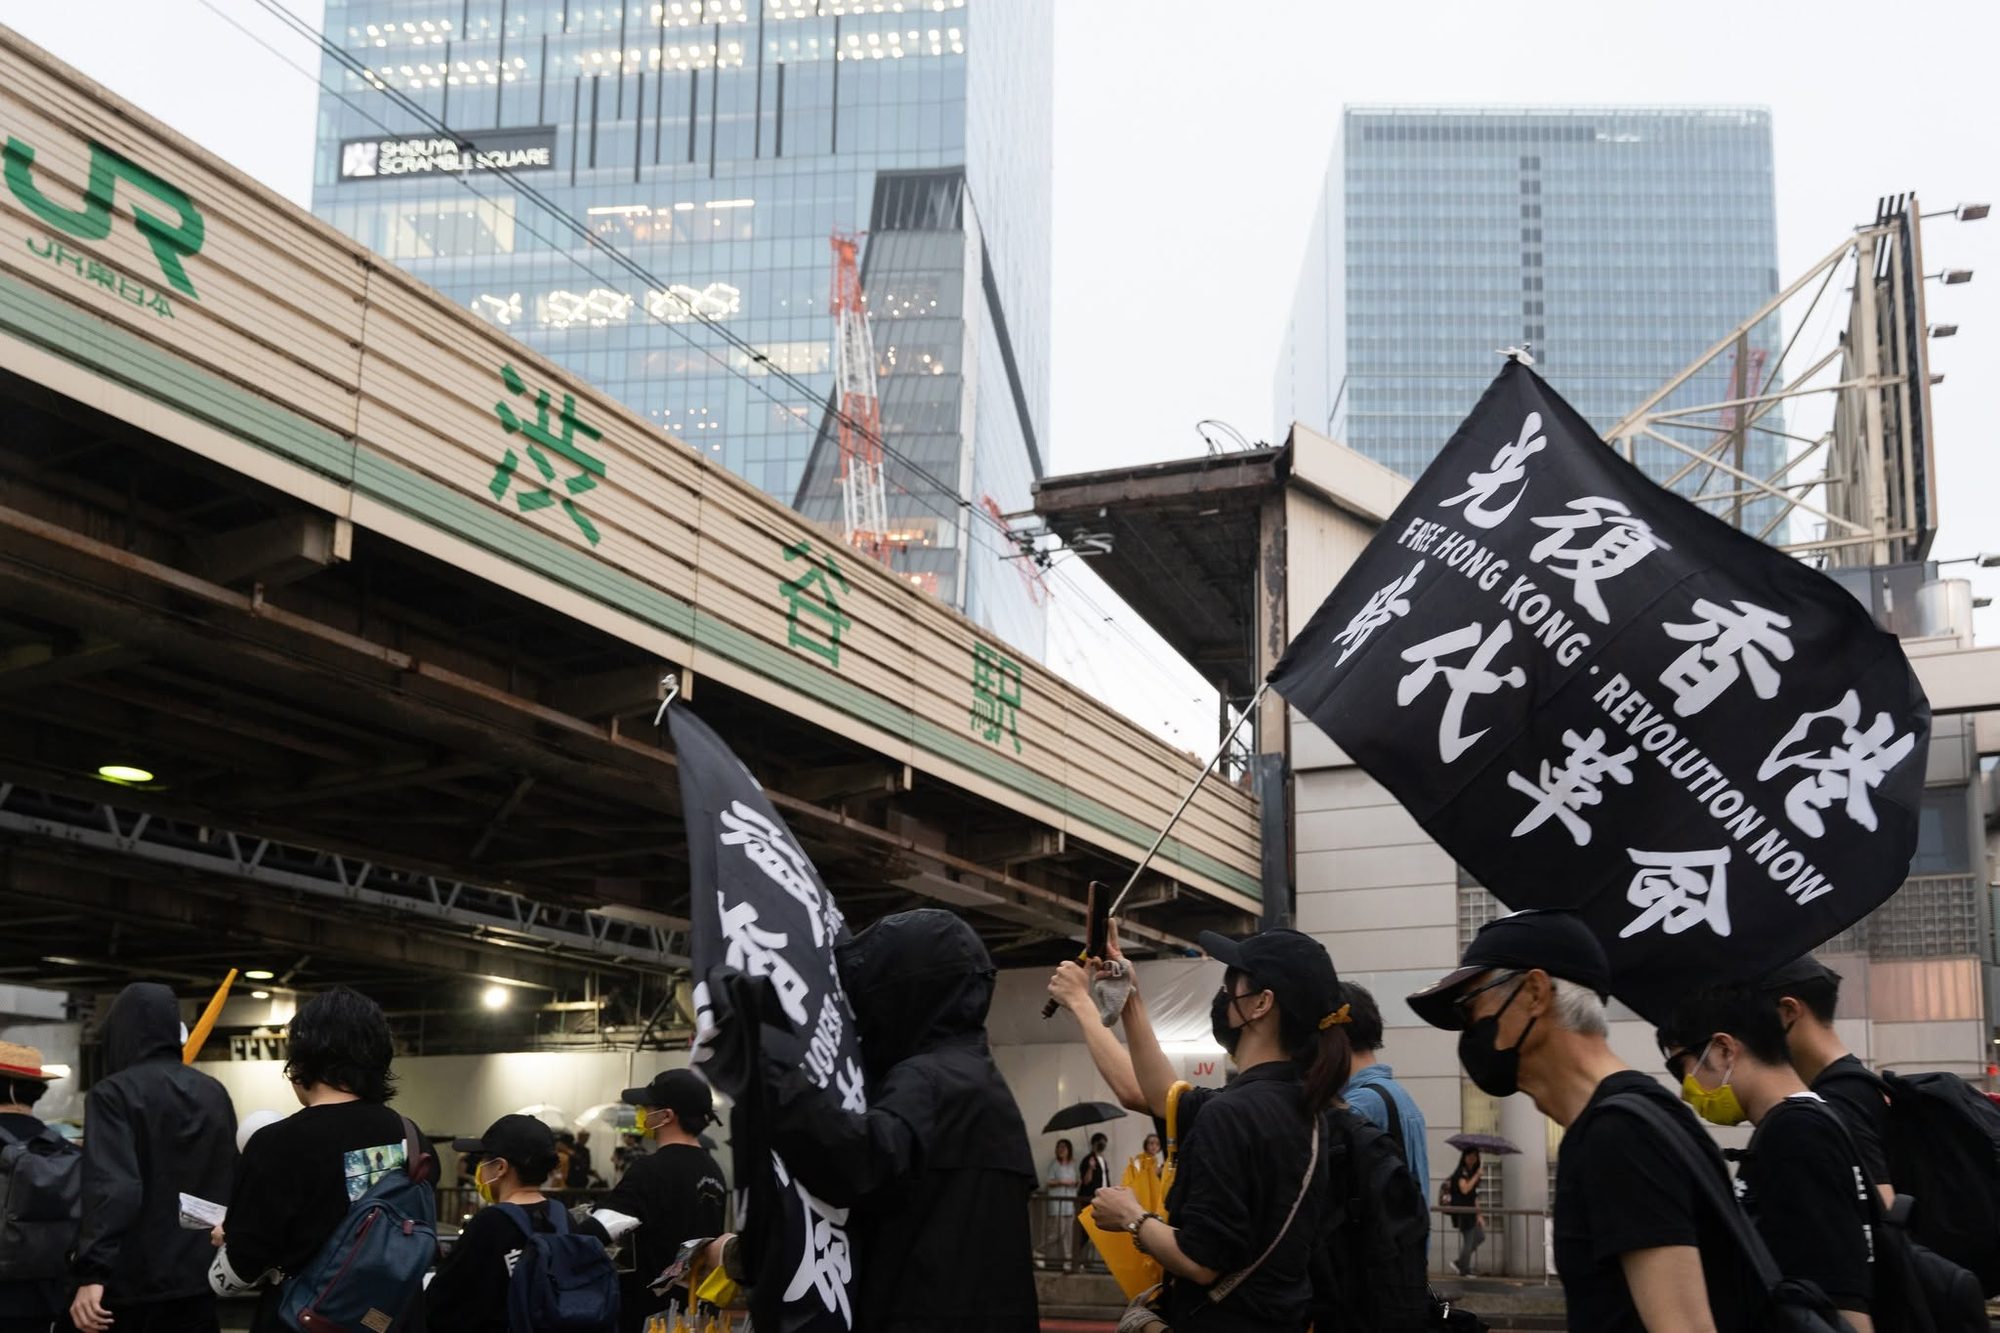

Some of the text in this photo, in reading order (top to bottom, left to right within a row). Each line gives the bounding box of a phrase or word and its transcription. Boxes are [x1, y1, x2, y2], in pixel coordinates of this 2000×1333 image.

[379, 138, 458, 158] SHIBUYA
[378, 147, 550, 175] SCRAMBLE SQUARE
[1396, 516, 1835, 906] FREE HONG KONG REVOLUTION NOW
[1192, 1061, 1216, 1077] JV
